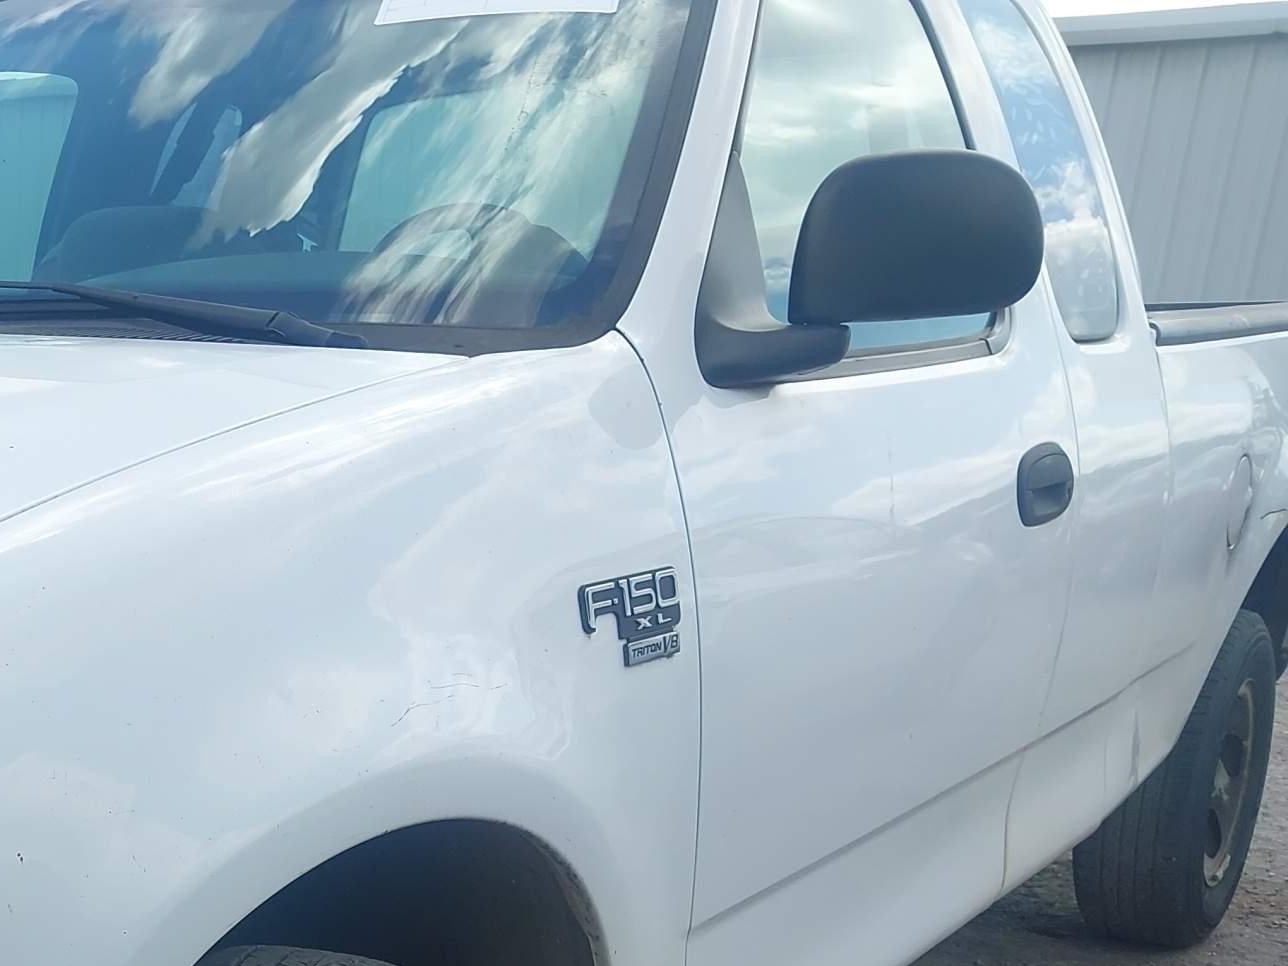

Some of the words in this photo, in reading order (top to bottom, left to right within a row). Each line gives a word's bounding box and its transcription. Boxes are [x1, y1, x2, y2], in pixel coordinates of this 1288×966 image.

[634, 612, 673, 630] XL
[631, 641, 663, 659] TRITON
[662, 633, 679, 654] V8
